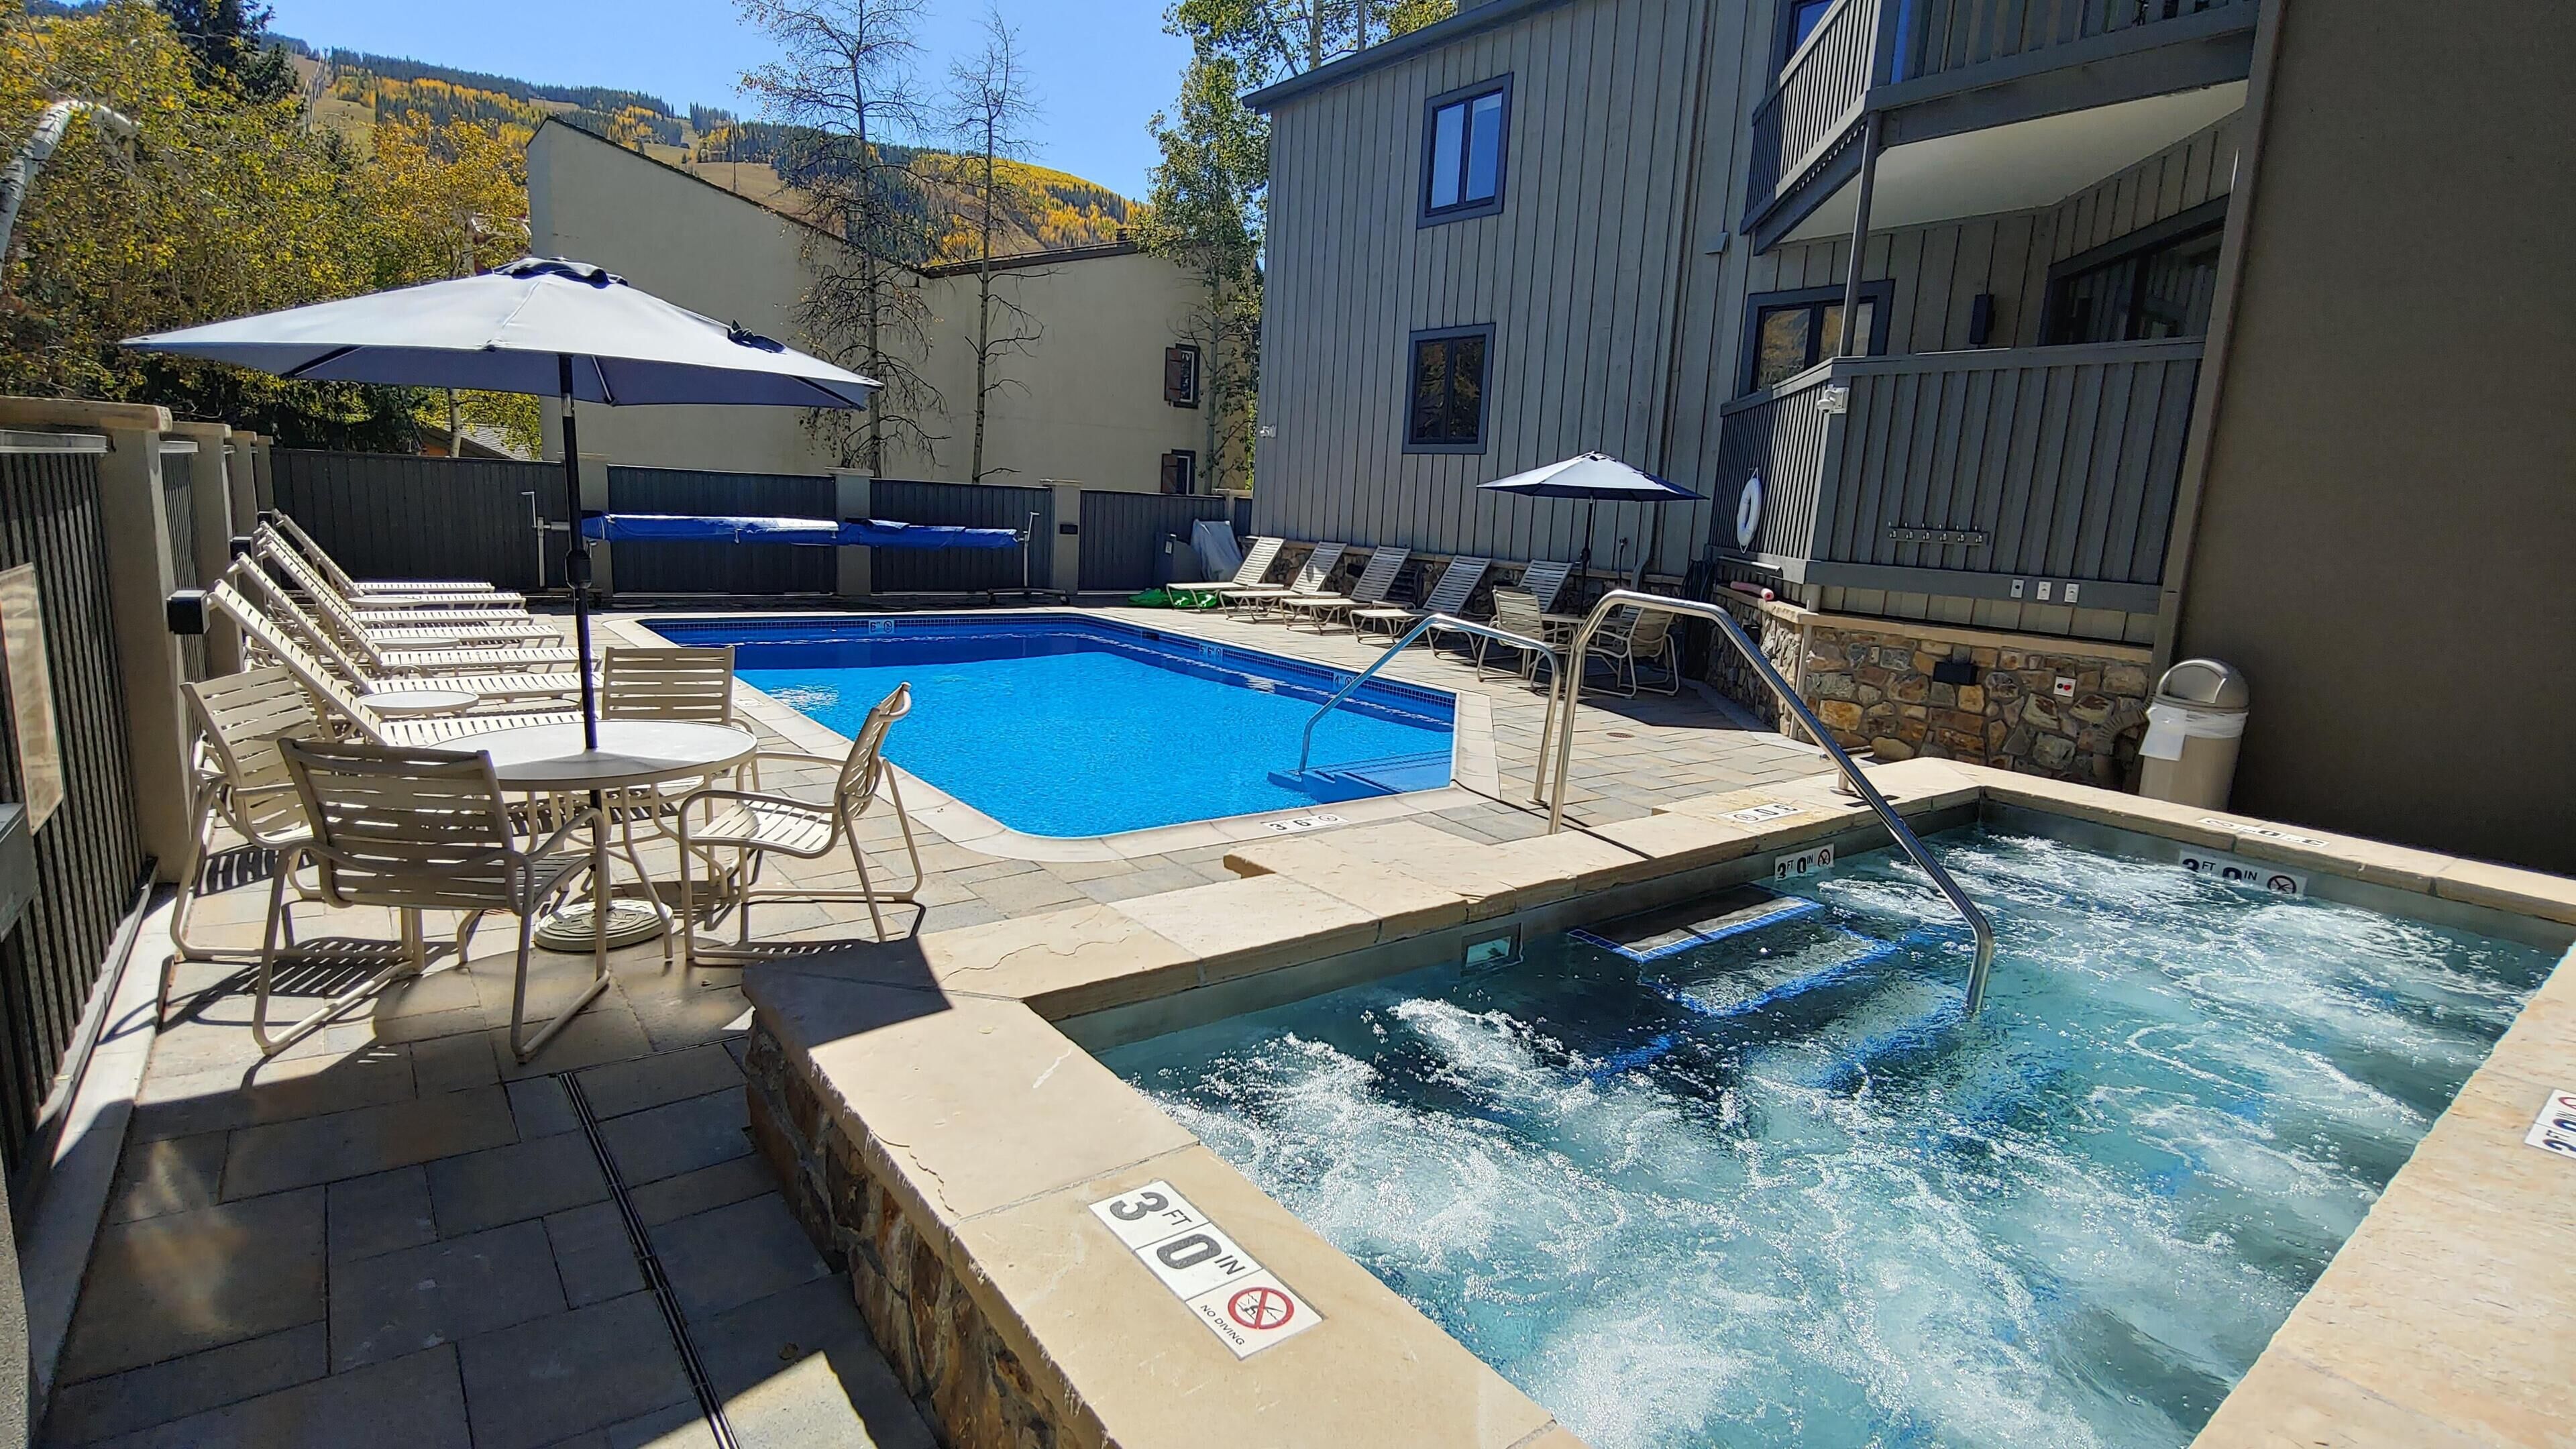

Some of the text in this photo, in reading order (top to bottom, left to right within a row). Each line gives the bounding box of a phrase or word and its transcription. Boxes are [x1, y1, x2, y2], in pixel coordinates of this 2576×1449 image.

[1293, 819, 1312, 827] 6
[1777, 853, 1814, 879] 3 FT 0 IN
[2202, 861, 2216, 871] FT
[2244, 869, 2258, 881] IN
[1109, 1191, 1246, 1276] 3 FT 0 IN
[1200, 1304, 1245, 1346] NO DIVING
